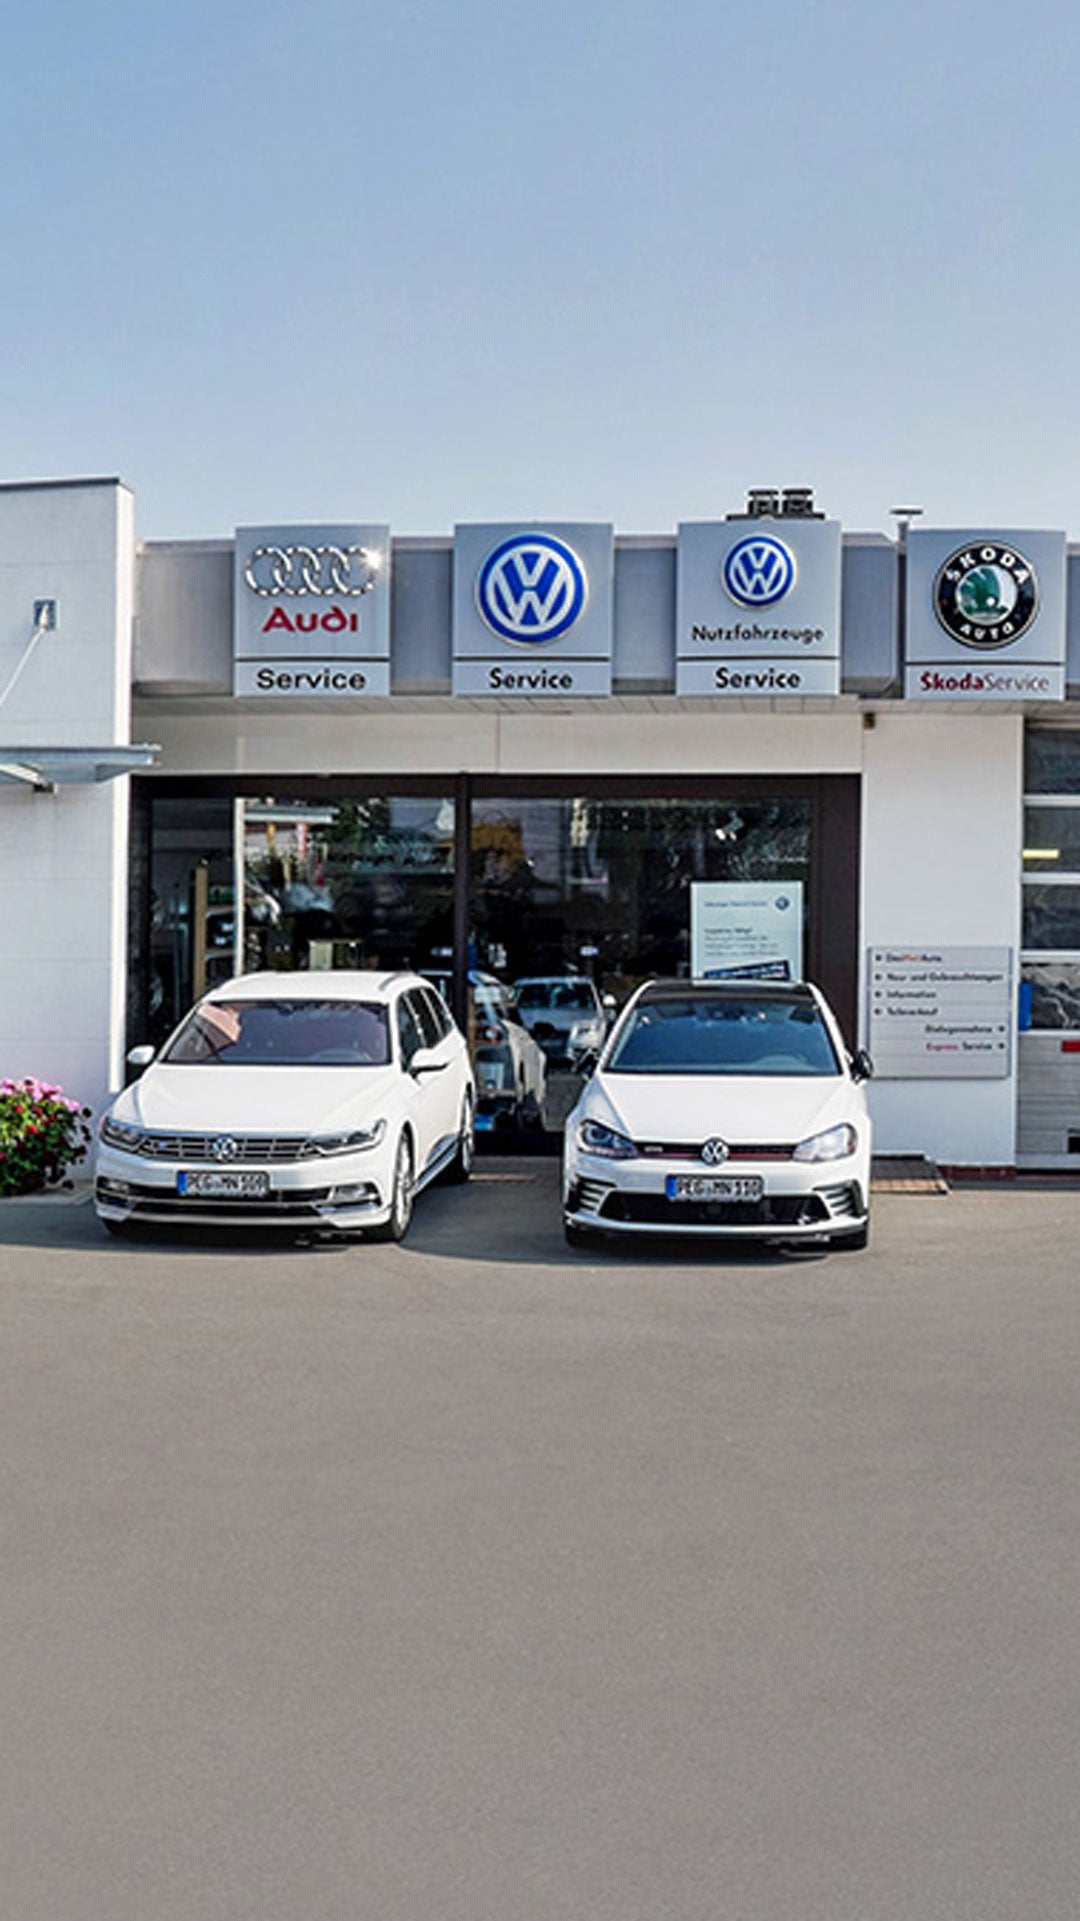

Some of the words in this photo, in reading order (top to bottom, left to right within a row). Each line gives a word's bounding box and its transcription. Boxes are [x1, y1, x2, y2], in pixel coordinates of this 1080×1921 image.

[261, 605, 358, 633] Audi
[691, 624, 824, 645] Nutzfahrzeuge
[959, 621, 1015, 640] AUTO
[257, 668, 366, 690] Service
[489, 667, 573, 689] Service
[715, 667, 801, 689] Service
